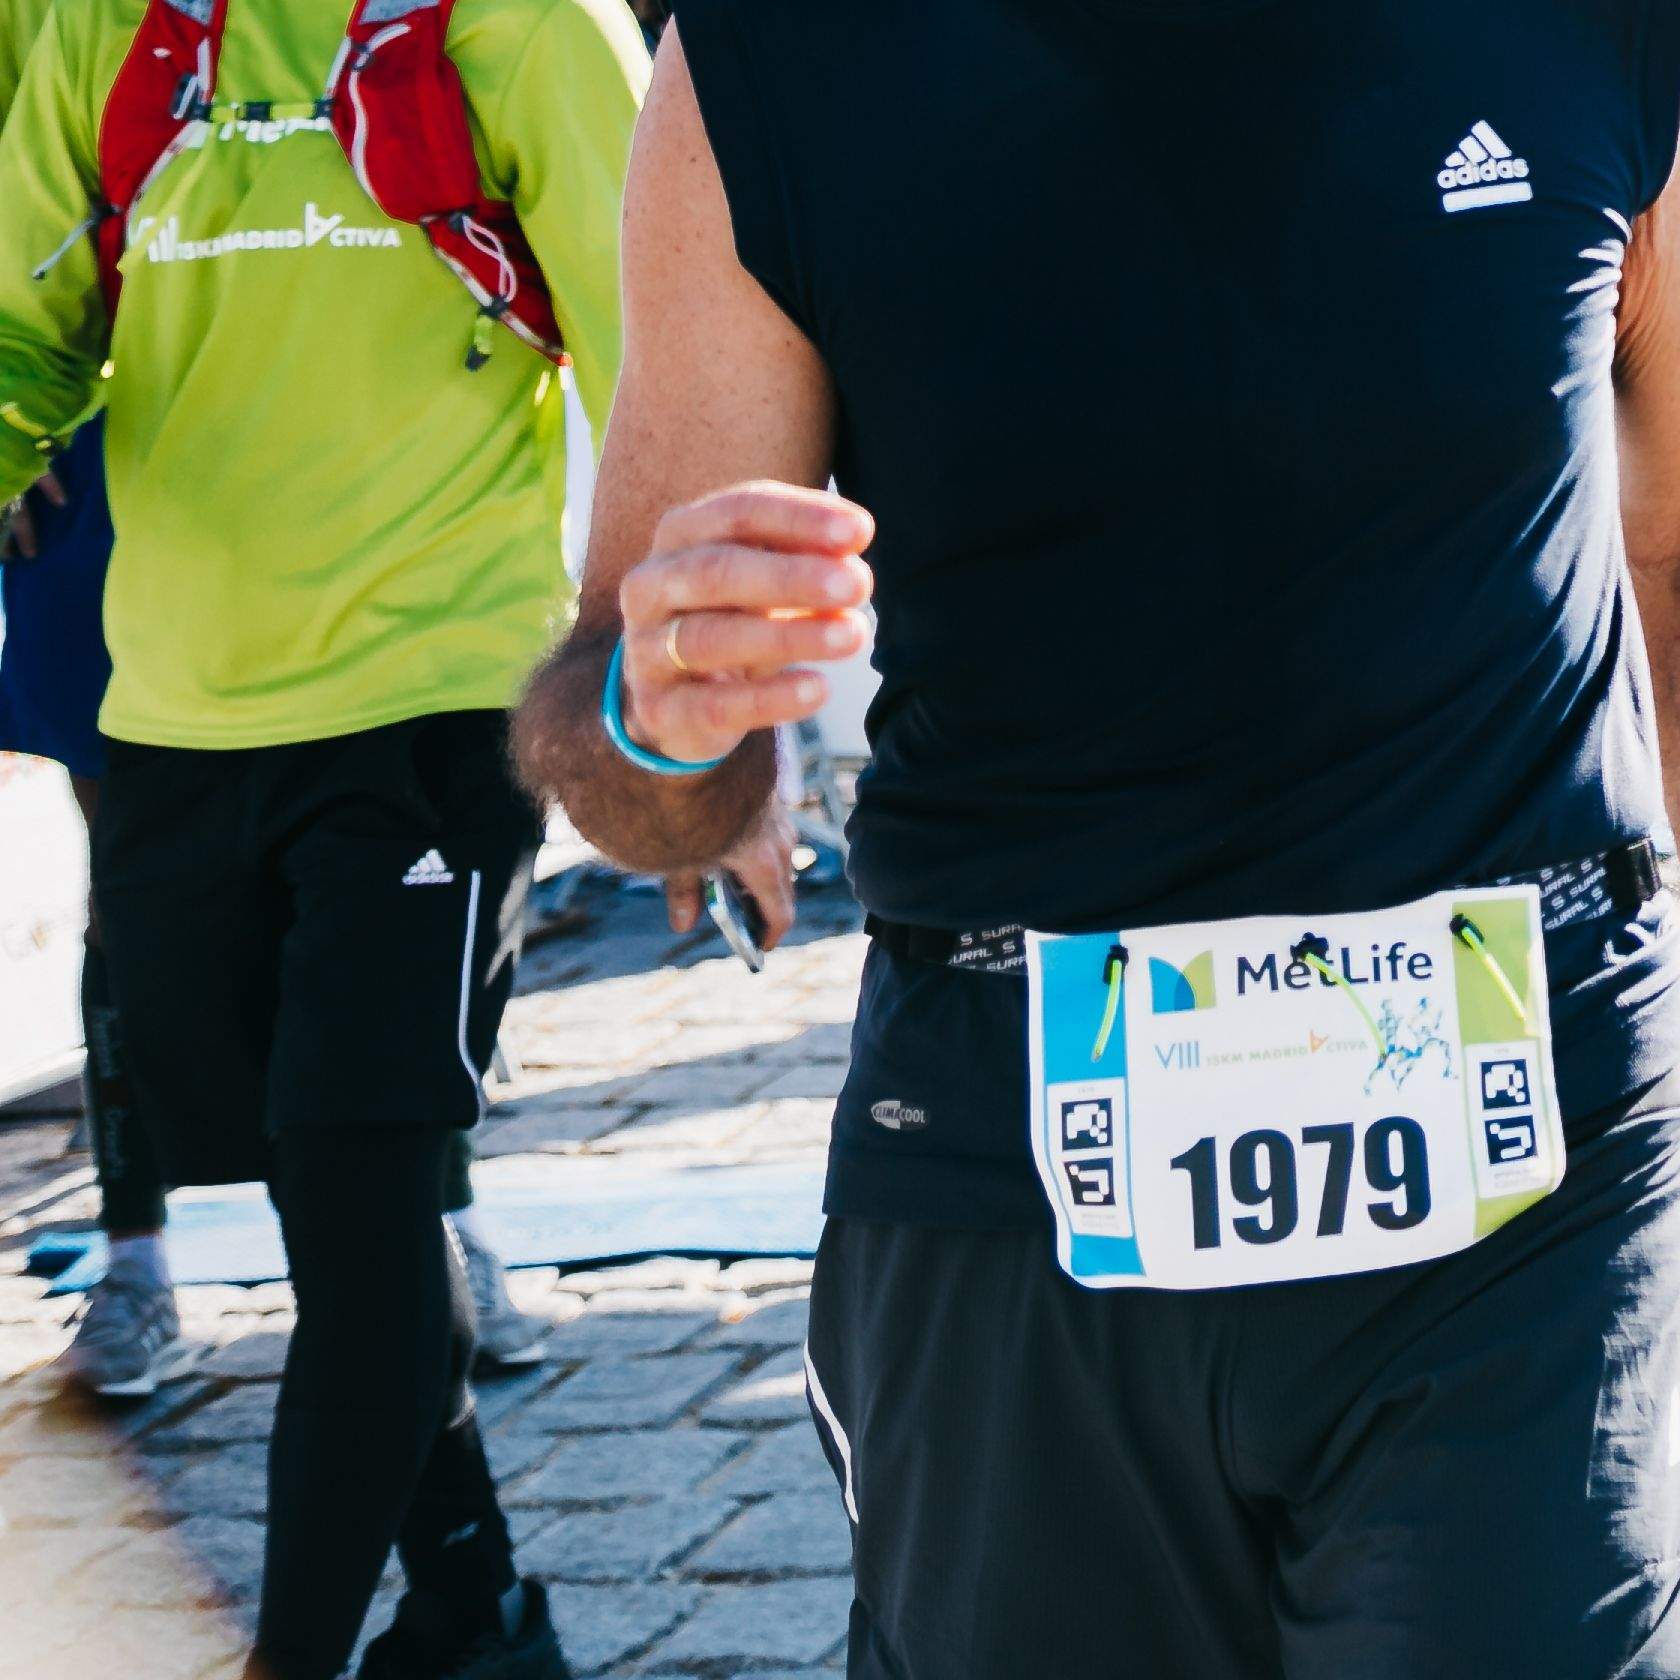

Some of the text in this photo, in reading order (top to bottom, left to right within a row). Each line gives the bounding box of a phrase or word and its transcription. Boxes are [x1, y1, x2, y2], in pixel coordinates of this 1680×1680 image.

[1436, 157, 1530, 189] adidas
[1235, 940, 1435, 998] MetLife
[1154, 1040, 1201, 1070] VIII
[1250, 1047, 1309, 1064] MADRID
[1169, 1115, 1433, 1253] 1979
